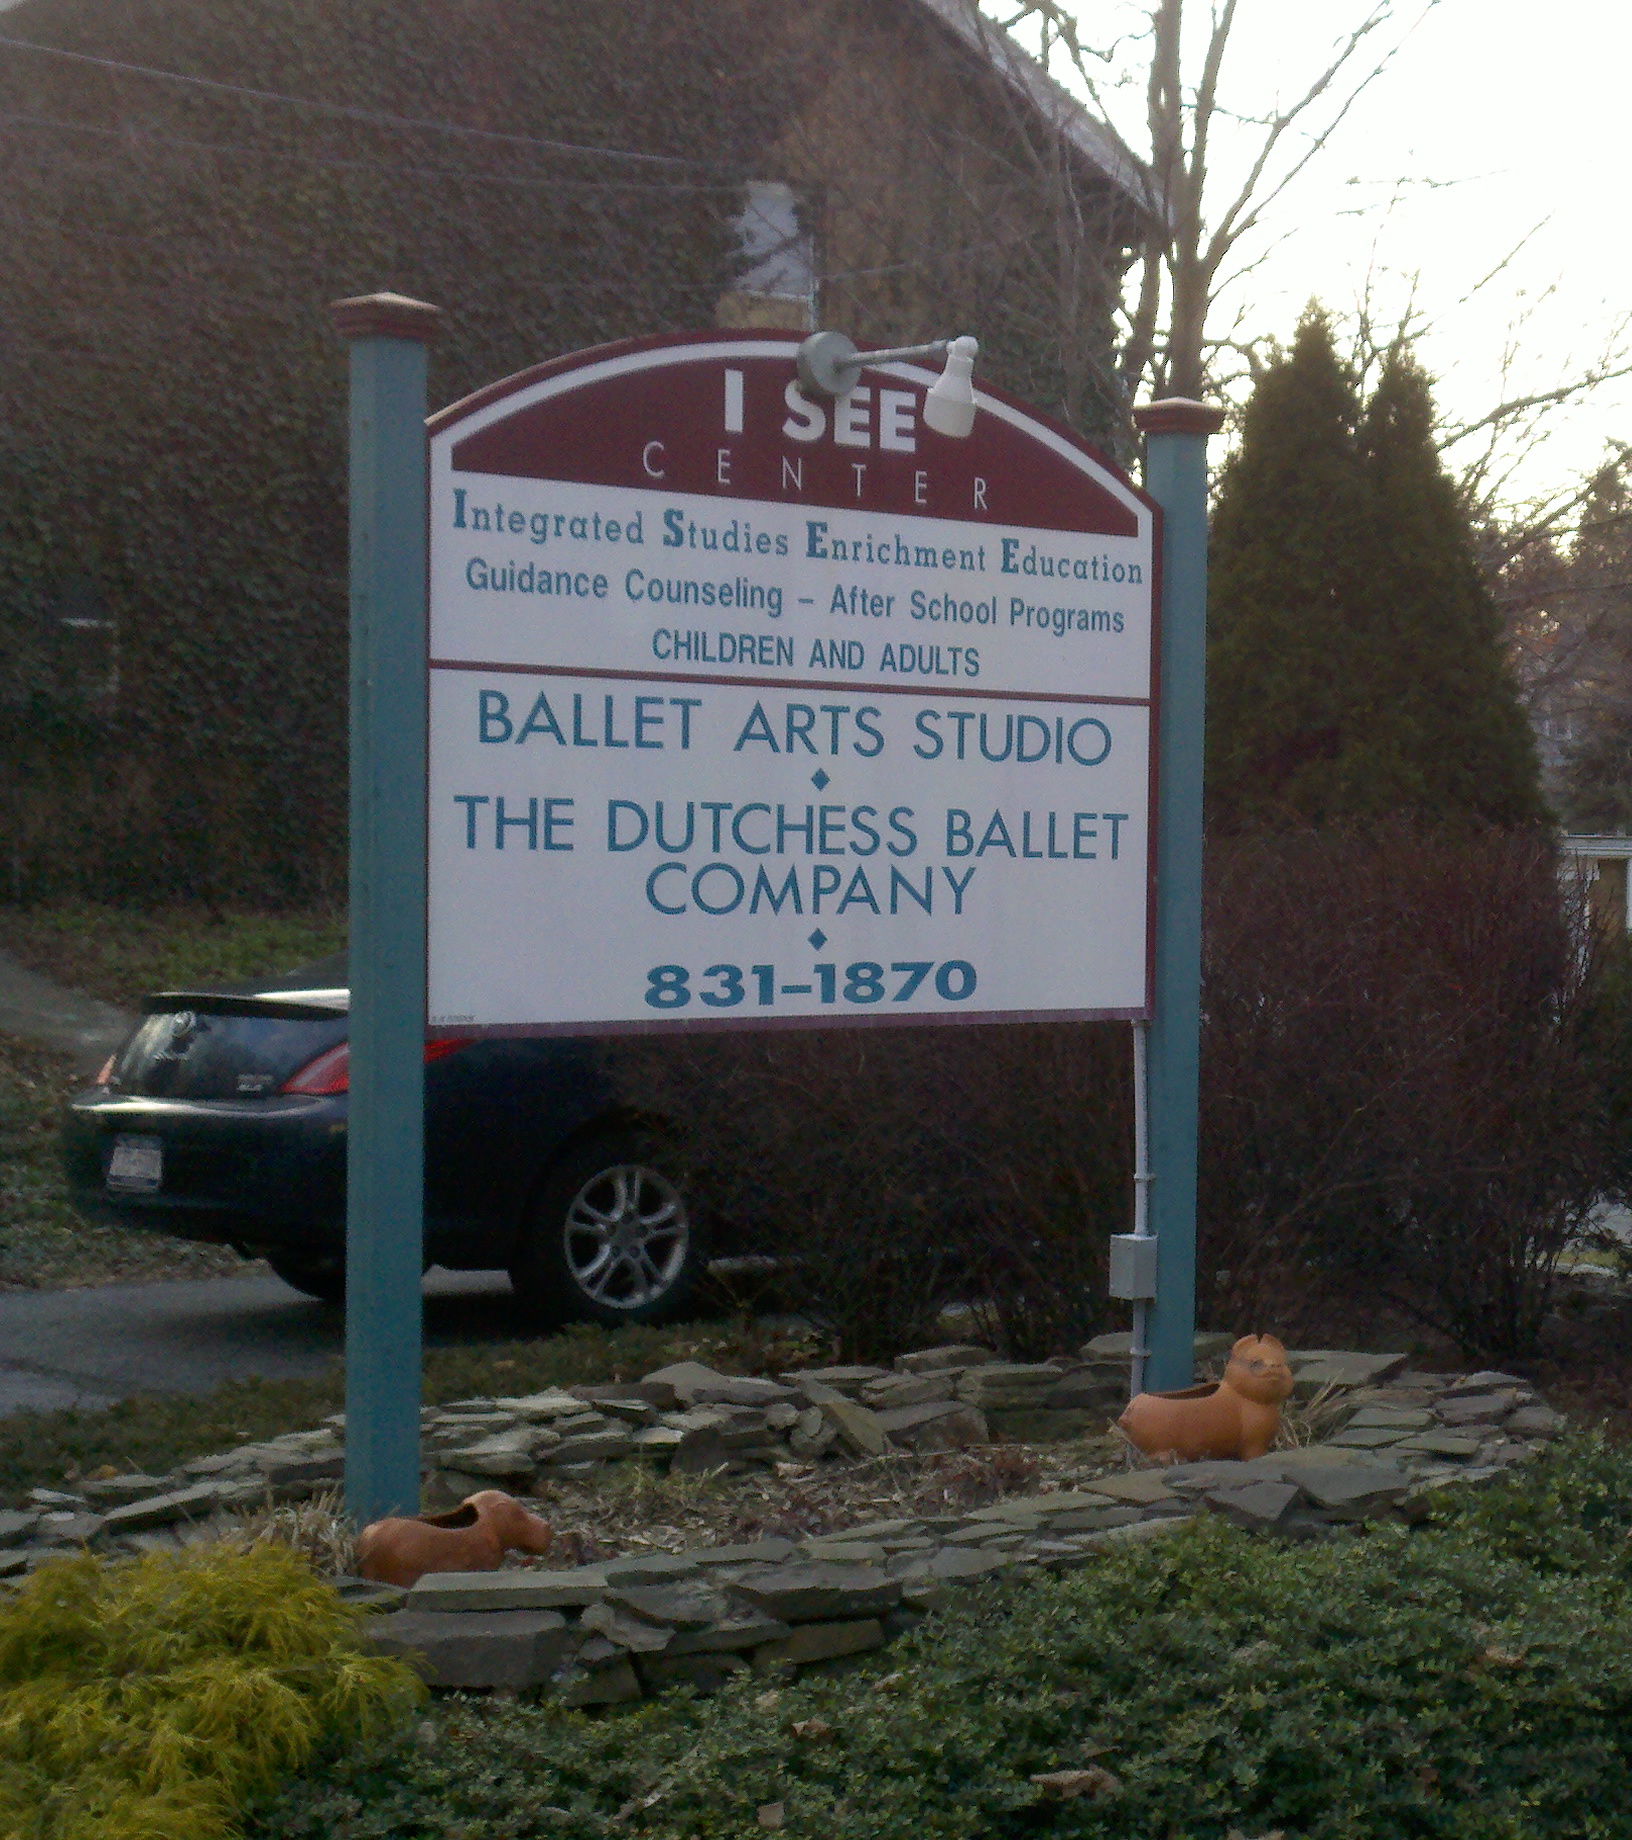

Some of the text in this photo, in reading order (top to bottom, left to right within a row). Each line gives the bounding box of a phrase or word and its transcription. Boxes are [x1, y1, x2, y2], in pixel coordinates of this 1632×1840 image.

[724, 368, 917, 454] I SEE
[641, 441, 988, 510] CENTER
[453, 487, 1143, 585] Integrated Studies Enrichment Education
[465, 556, 609, 599] Guidance
[624, 567, 783, 618] Counseling
[829, 583, 896, 618] After
[909, 589, 998, 625] School
[1009, 596, 1125, 638] Programs
[651, 627, 981, 678] CHILDREN AND ADULTS
[477, 689, 1112, 767] BALLET ARTS STUDIO
[453, 794, 1130, 861] THE DUTCHESS BALLET
[645, 862, 977, 916] COMPANY
[643, 959, 978, 1009] 831-1870
